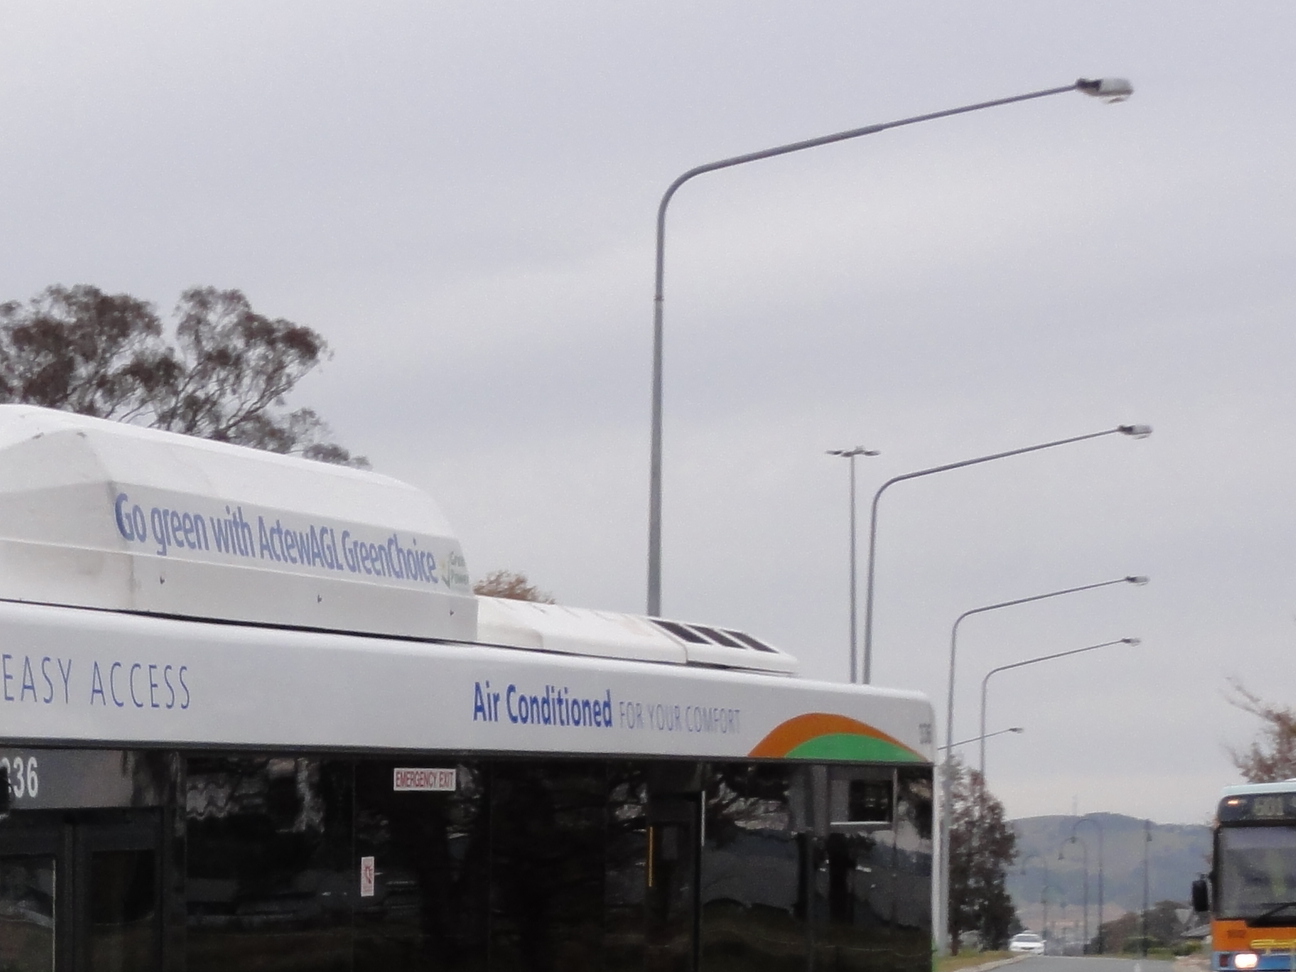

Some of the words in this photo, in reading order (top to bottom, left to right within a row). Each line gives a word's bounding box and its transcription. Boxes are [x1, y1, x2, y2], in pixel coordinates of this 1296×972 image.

[115, 493, 147, 542] Go
[150, 507, 209, 556] green
[209, 505, 256, 558] with
[258, 516, 344, 571] ActewAGL
[341, 530, 438, 584] GreenChoice
[2, 654, 72, 704] EASY
[90, 661, 190, 709] ACCESS
[473, 680, 500, 722] Air
[506, 684, 612, 728] Conditioned
[619, 701, 644, 729] FOR
[647, 703, 683, 732] YOUR
[685, 705, 740, 734] COMFORT
[395, 770, 437, 788] EMERGENCY
[439, 771, 454, 788] EXIT
